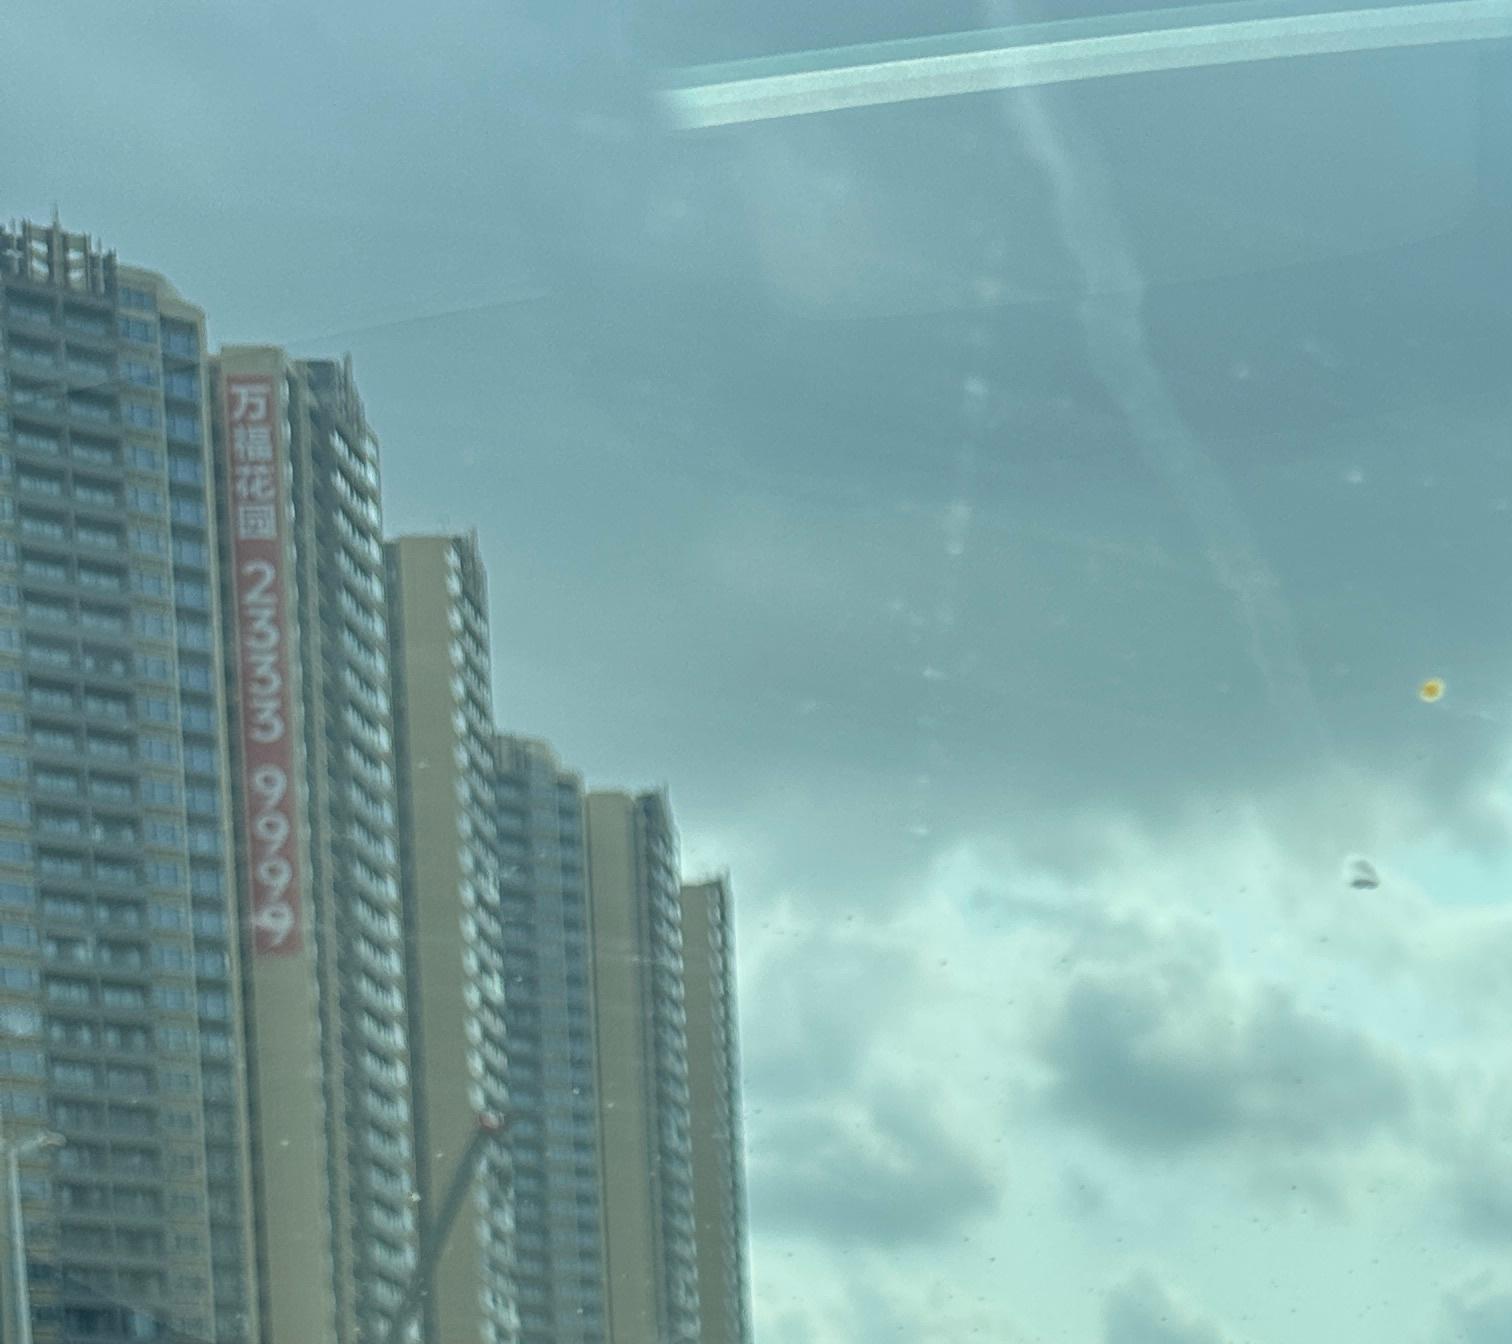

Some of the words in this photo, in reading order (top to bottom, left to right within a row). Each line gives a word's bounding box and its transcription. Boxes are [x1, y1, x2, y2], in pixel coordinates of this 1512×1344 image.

[229, 382, 279, 541] 万福花园
[240, 559, 285, 744] 2333
[249, 763, 296, 951] 9999
